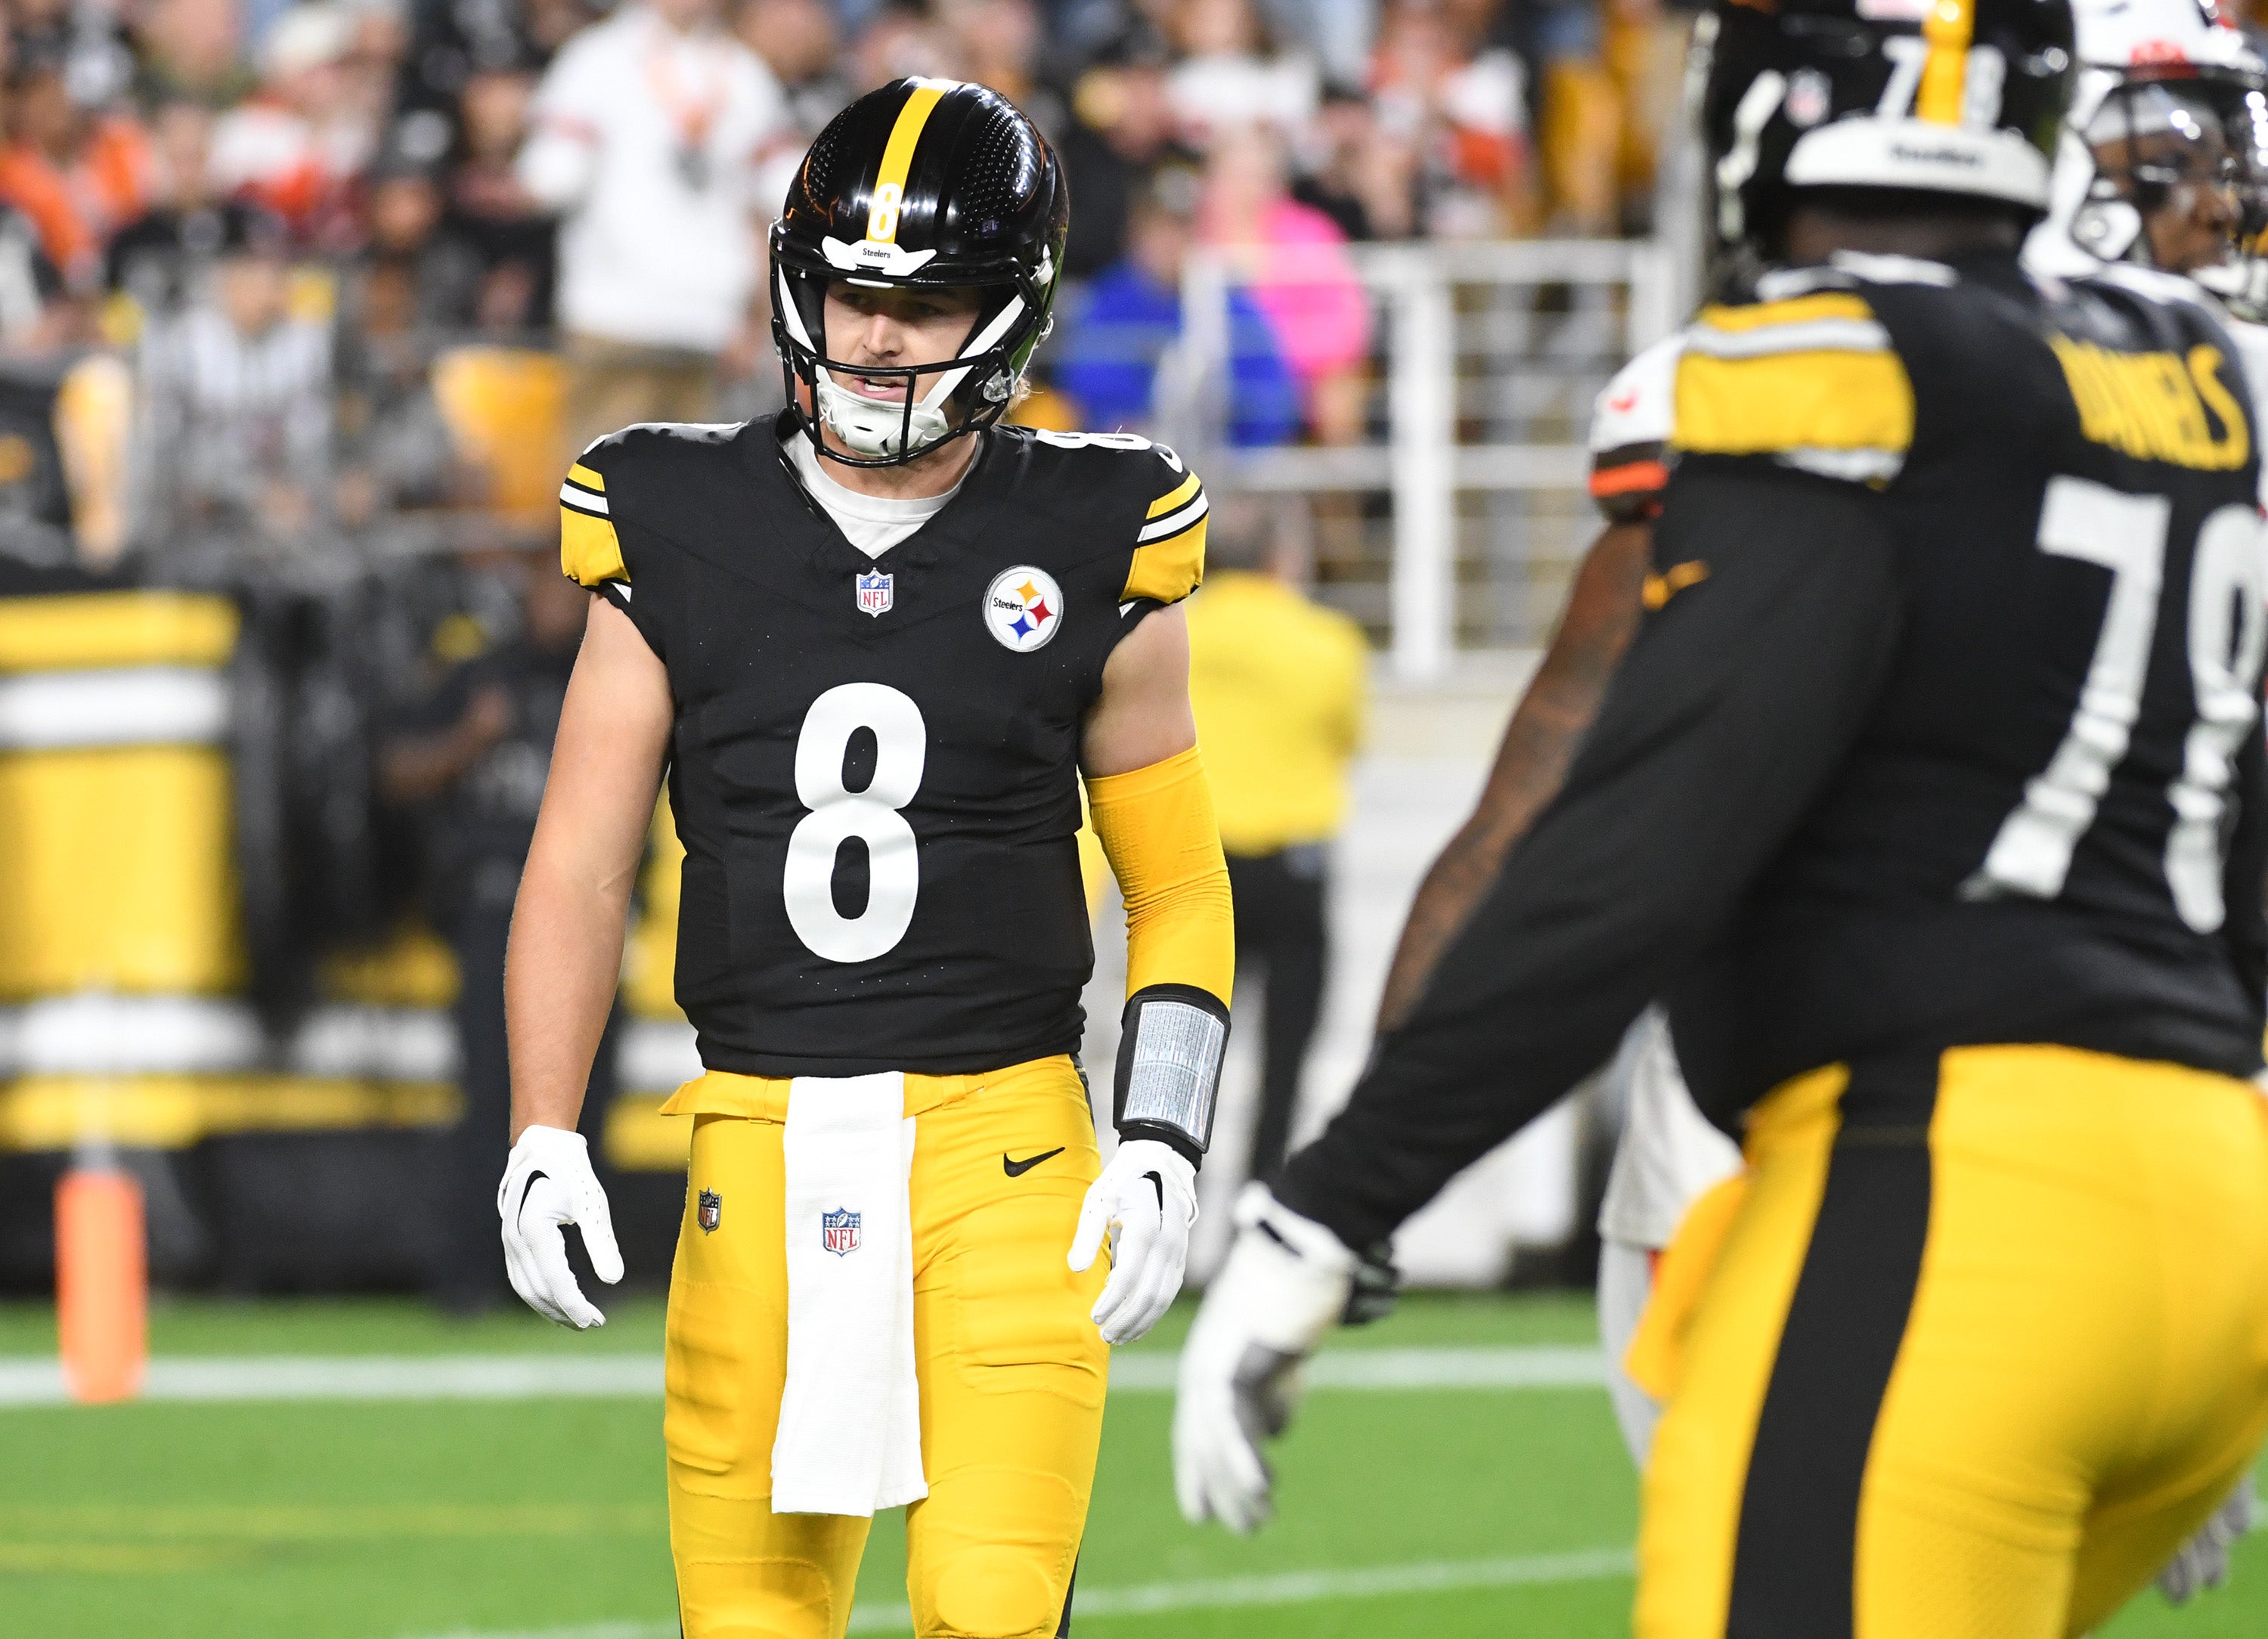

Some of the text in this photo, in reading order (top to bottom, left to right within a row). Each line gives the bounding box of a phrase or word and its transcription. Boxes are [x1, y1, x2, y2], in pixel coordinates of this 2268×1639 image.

[867, 182, 902, 240] 8
[863, 247, 891, 259] Steelers
[863, 591, 887, 608] NFL
[993, 597, 1023, 612] Steelers
[783, 682, 927, 963] 8
[826, 1228, 857, 1250] NFL
